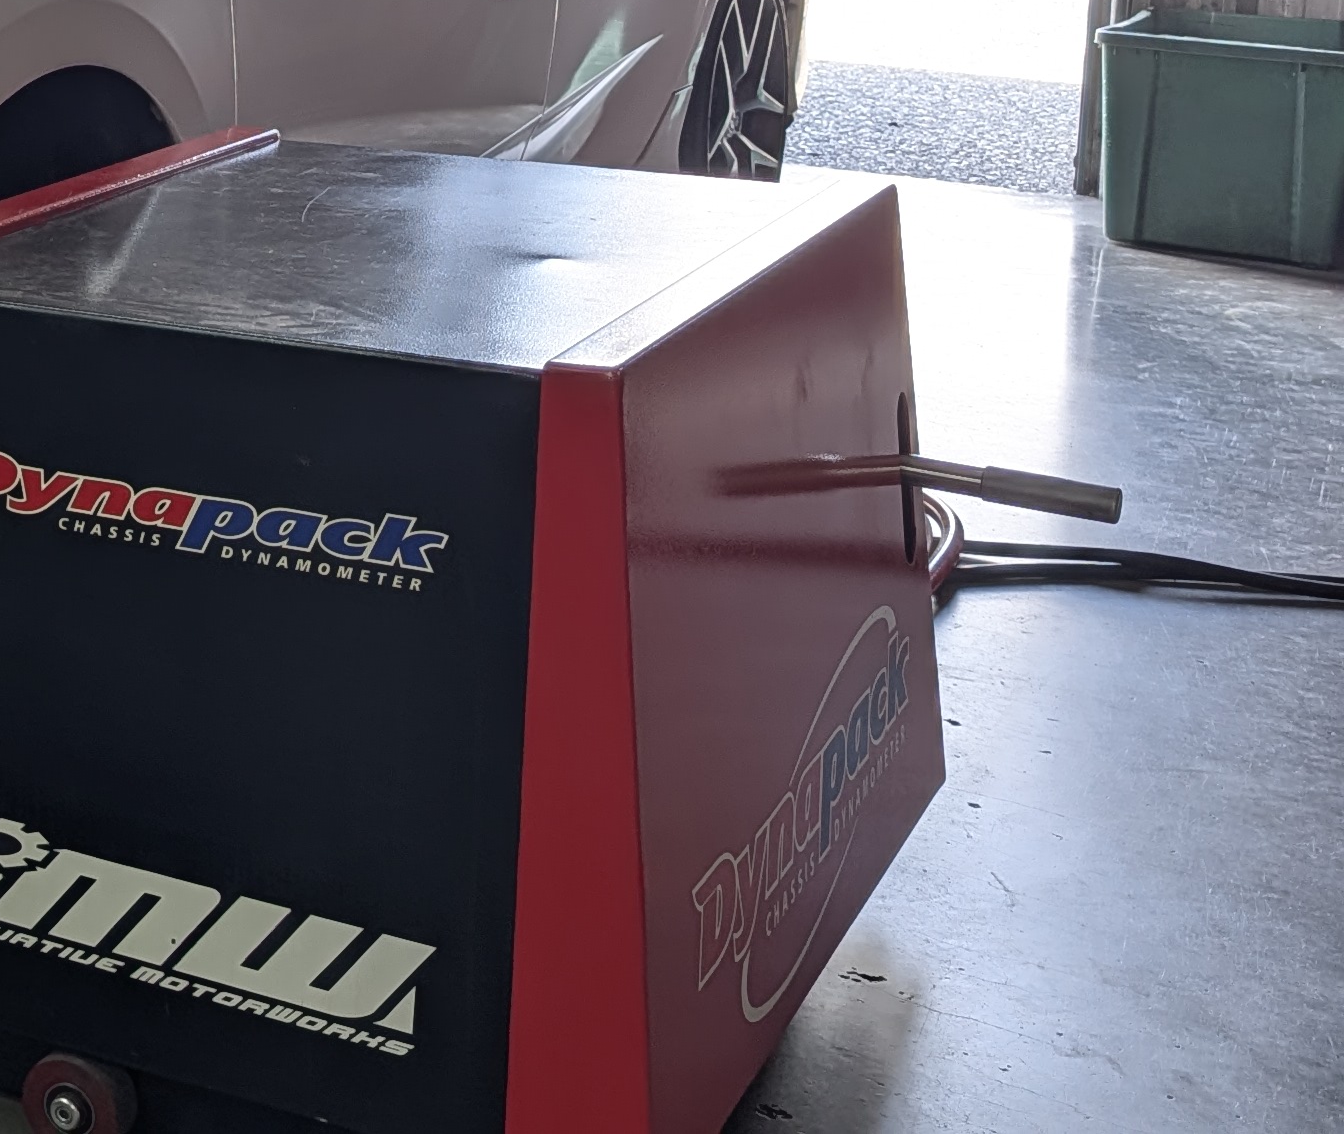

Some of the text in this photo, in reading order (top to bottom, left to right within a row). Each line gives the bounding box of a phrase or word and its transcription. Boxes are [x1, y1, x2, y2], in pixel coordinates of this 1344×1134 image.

[58, 516, 424, 593] CHASSIS DYNAMOMETER
[691, 629, 910, 992] Dynapack
[765, 723, 907, 938] CHASSIS DYNAMOMETER
[129, 965, 416, 1059] MOTORWORKS
